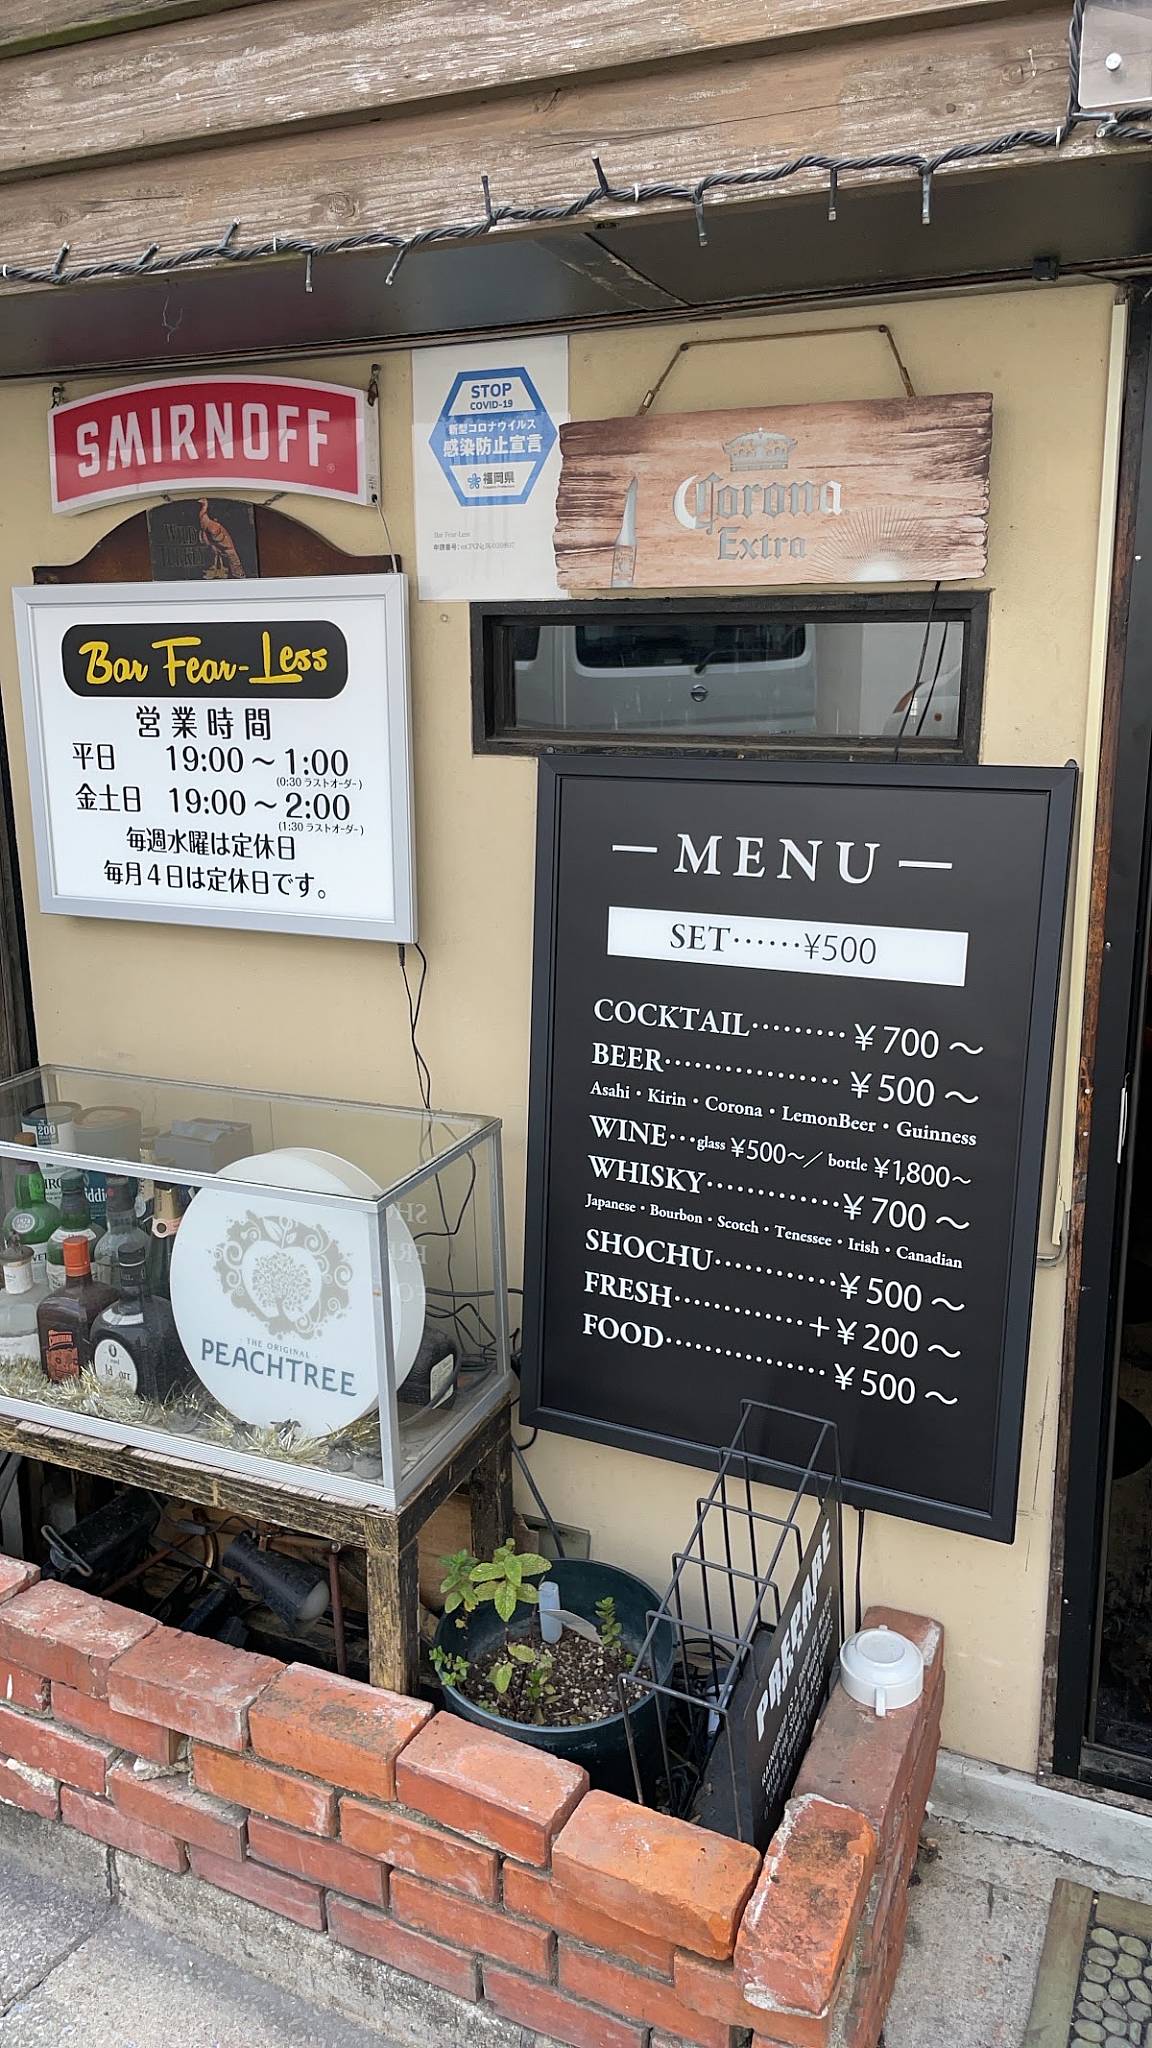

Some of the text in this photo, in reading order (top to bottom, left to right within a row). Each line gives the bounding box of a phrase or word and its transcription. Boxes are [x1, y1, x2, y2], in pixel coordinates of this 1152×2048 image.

[470, 399, 513, 410] COVID-19
[471, 383, 512, 399] STOP
[76, 402, 330, 478] SMIRNOFF
[443, 433, 543, 458] 感染防止宣言
[448, 419, 537, 436] 新型コロナウイルス
[483, 471, 515, 485] 福岡県
[673, 472, 843, 534] Corona
[717, 526, 807, 561] Extra
[79, 631, 329, 687] Bar Fear-Less
[135, 705, 272, 740] 営業時間
[72, 742, 116, 771] 平日
[75, 783, 142, 813] 金土日
[126, 826, 296, 861] 毎週水曜は定休日
[674, 833, 881, 885] MENU
[670, 923, 877, 965] SET ¥500
[594, 998, 751, 1038] COCKTAIL
[592, 1042, 665, 1073] BEER
[37, 1125, 56, 1136] 200
[589, 1081, 977, 1147] Asahi Kirin Corona LemonBeer Guinness
[590, 1114, 668, 1148] WINE
[696, 1136, 726, 1152] glass
[828, 1153, 868, 1172] bottle
[587, 1154, 706, 1194] WHISKY
[585, 1193, 963, 1269] Japanese Bourbon Scotch Tenessee Irish Canadian
[585, 1228, 714, 1272] SHOCHU
[584, 1270, 673, 1309] FRESH
[246, 1337, 310, 1359] THE ORIGINAL
[582, 1313, 664, 1350] FOOD
[201, 1338, 358, 1397] PEACHTREE
[756, 1518, 832, 1742] PREPARE
